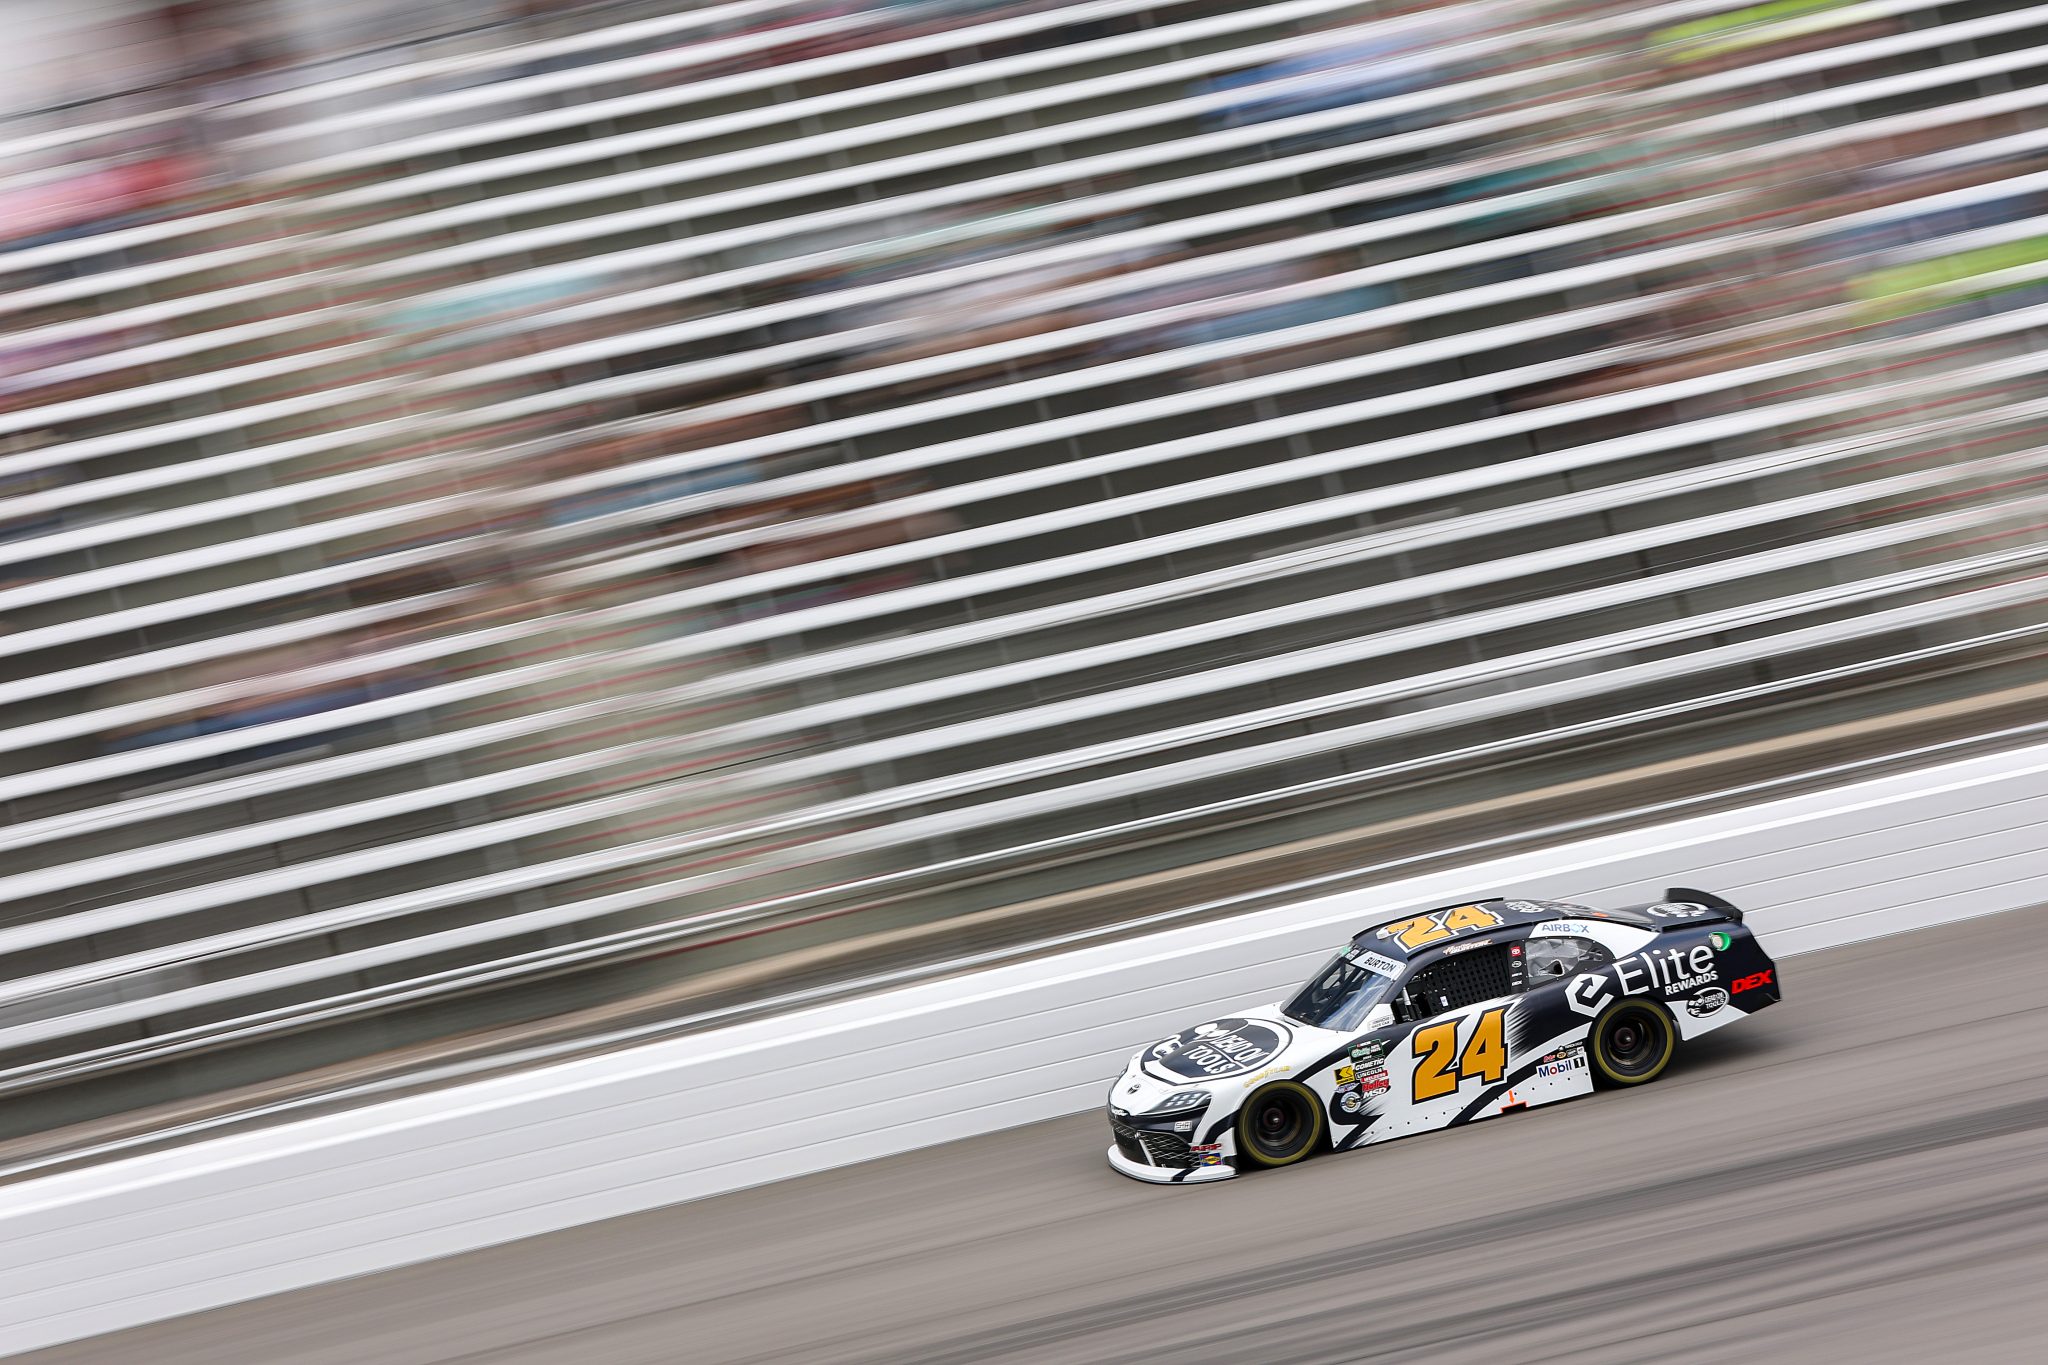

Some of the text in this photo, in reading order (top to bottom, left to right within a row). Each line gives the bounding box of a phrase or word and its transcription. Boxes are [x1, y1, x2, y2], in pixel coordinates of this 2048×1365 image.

[1378, 904, 1503, 952] 24
[1541, 923, 1589, 934] AIRBOX
[1364, 957, 1397, 973] BURTON
[1612, 945, 1715, 996] Elite
[1664, 970, 1719, 996] REWARDS
[1732, 969, 1773, 994] DEX
[1706, 999, 1725, 1010] TOOLS
[1182, 1045, 1236, 1075] TOOLS
[1412, 1005, 1509, 1105] 24
[1355, 1058, 1384, 1071] COMETIC
[1538, 1057, 1586, 1078] Mobil 1
[1357, 1067, 1384, 1079] LINCOLN
[1362, 1080, 1390, 1092] Holley
[1363, 1087, 1388, 1099] MSD
[1190, 1143, 1223, 1152] ARP
